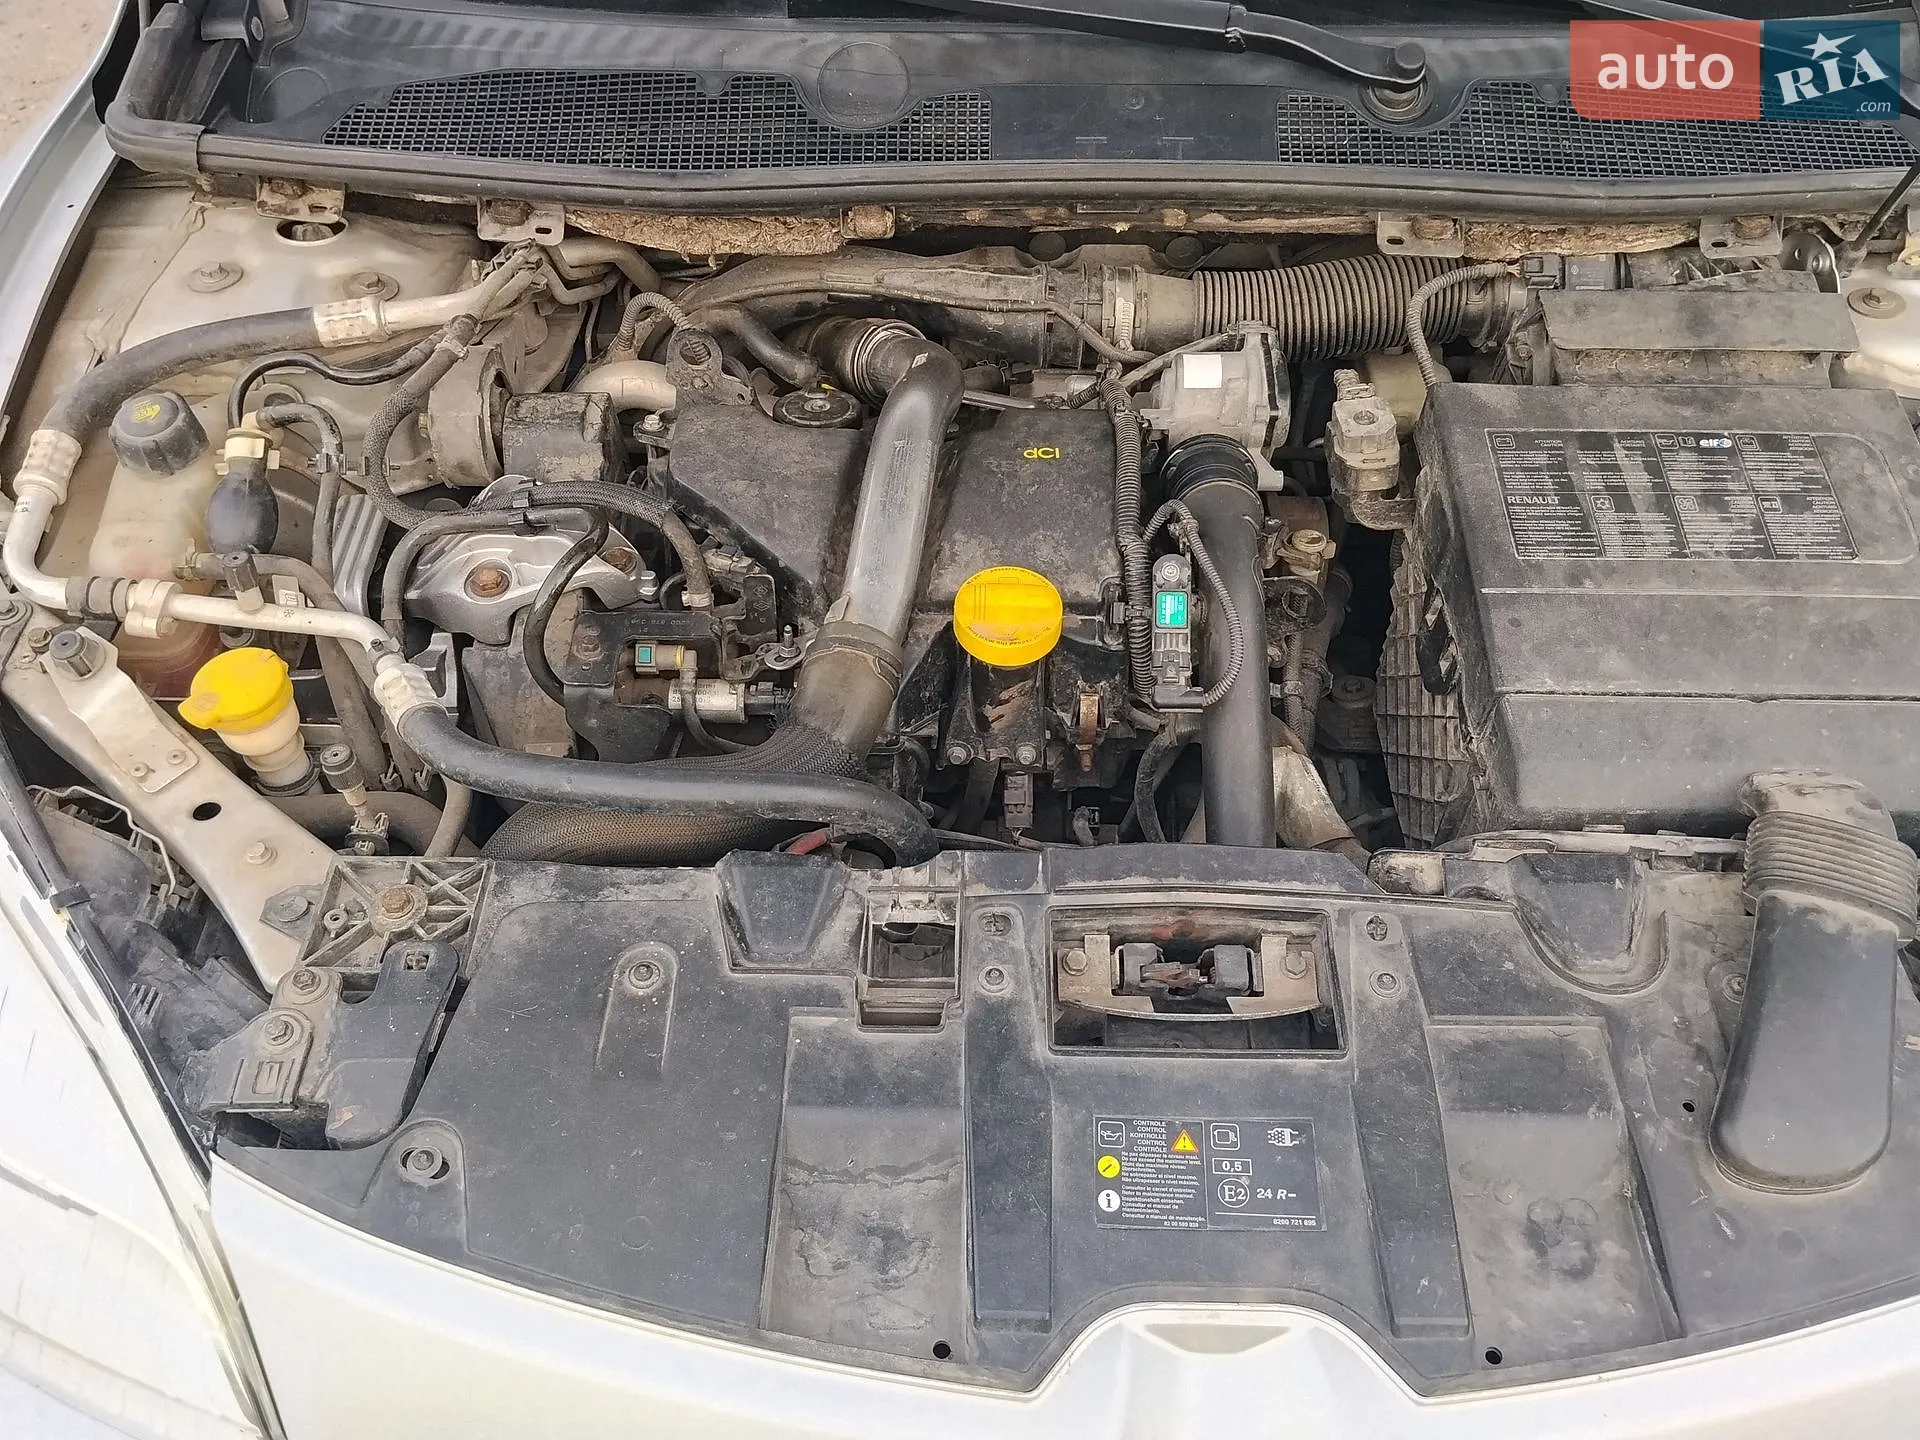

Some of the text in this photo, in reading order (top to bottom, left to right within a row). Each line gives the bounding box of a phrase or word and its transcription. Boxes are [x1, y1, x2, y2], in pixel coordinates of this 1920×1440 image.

[1507, 496, 1560, 504] RENAULT
[1222, 1161, 1243, 1173] 0,5
[1222, 1184, 1247, 1202] E2
[1256, 1188, 1273, 1199] 24
